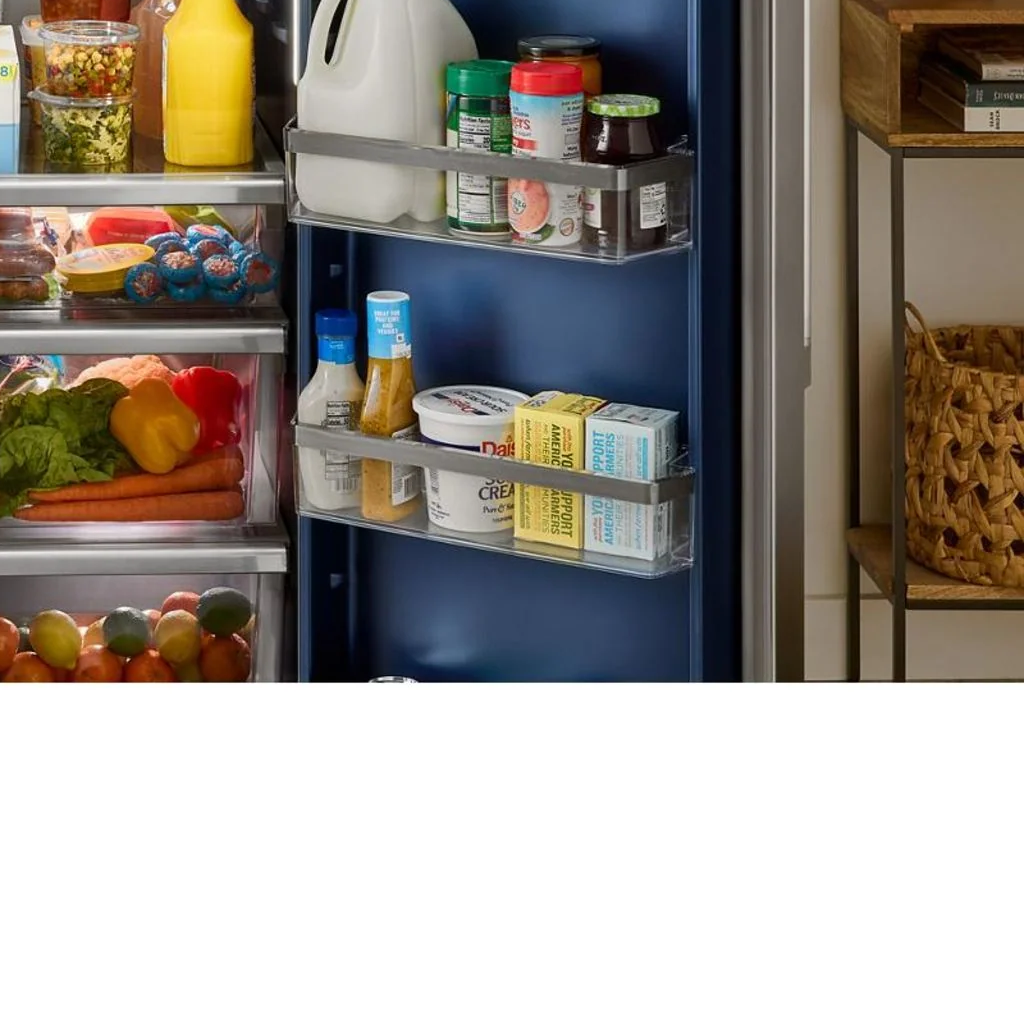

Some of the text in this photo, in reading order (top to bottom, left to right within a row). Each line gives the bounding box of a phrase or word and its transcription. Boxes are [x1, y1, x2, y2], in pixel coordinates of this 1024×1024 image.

[0, 65, 9, 77] 8
[592, 430, 605, 474] PPORT
[615, 434, 624, 476] UNITIES
[478, 485, 516, 501] CREA
[550, 423, 561, 535] AMERIC ARMERS
[561, 453, 574, 538] YO UPPORT
[604, 433, 615, 545] AMERIC RMERS
[541, 488, 551, 534] MUNITIES
